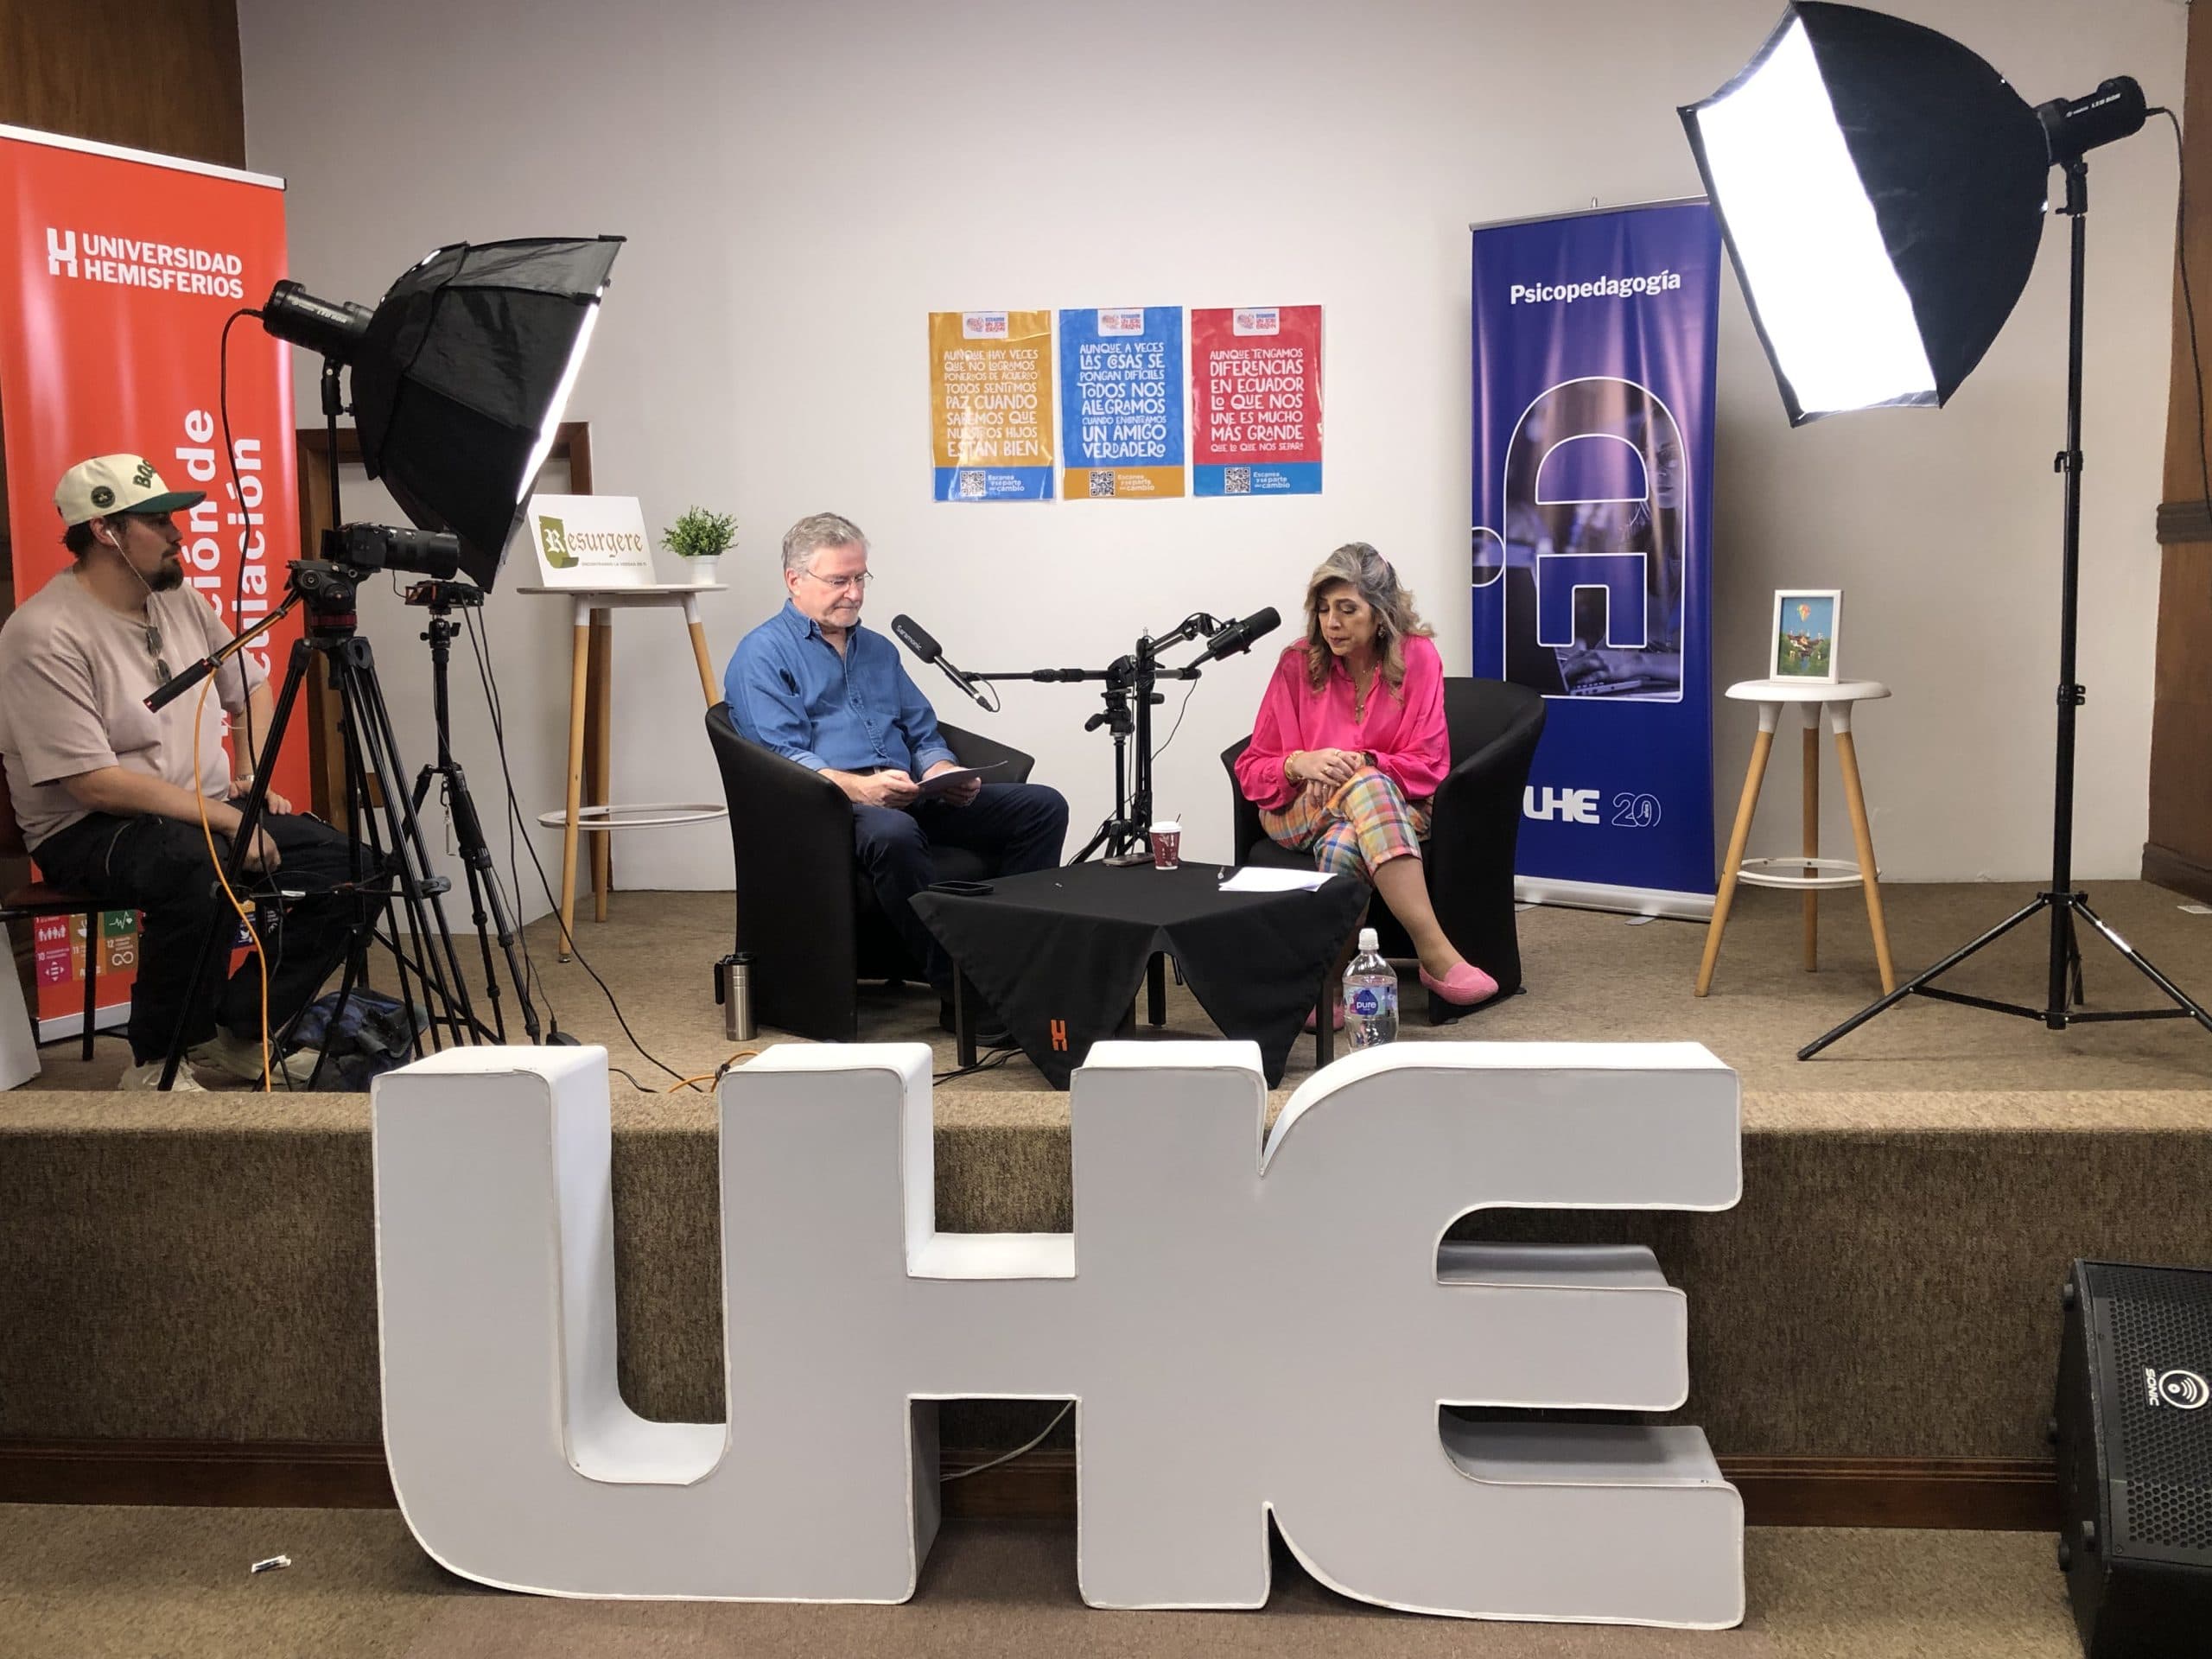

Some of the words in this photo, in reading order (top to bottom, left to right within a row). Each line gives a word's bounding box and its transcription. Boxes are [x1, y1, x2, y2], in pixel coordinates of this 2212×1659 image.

[82, 233, 243, 276] UNIVERSIDAD
[84, 258, 244, 299] HEMISFERIOS
[1510, 270, 1681, 304] Psicopedagogía
[944, 348, 985, 360] AUNQUE
[988, 350, 1006, 359] HAY
[1009, 349, 1039, 359] VECES
[1080, 343, 1122, 354] AUNQUE
[1125, 344, 1132, 353] A
[1134, 342, 1164, 353] VECES
[1210, 350, 1250, 359] AUNQUE
[1250, 348, 1303, 359] TENGAMOS
[944, 361, 966, 372] QUE
[969, 361, 985, 372] NO
[988, 361, 1035, 371] LOGRAMOS
[1080, 355, 1102, 370] LAS
[1147, 353, 1166, 368] SE
[1210, 359, 1303, 377] DIFERENCIAS
[1080, 371, 1121, 381] PONGAN
[944, 383, 981, 394] TODOS
[984, 382, 1037, 393] SENTIMOS
[1077, 382, 1126, 398] TODOS
[1131, 382, 1166, 397] NOS
[1211, 379, 1231, 394] EN
[1237, 377, 1305, 393] ECUADOR
[946, 396, 969, 410] PAZ
[974, 395, 1038, 410] CUANDO
[1082, 398, 1166, 415] ALEGRAMOS
[1211, 395, 1224, 410] LO
[1230, 394, 1264, 410] QUE
[1269, 394, 1303, 409] NOS
[1008, 410, 1038, 424] QUE
[1082, 416, 1114, 425] CUANDO
[1211, 412, 1236, 424] UNE
[1240, 412, 1254, 423] ES
[1258, 410, 1303, 423] MUCHO
[1007, 427, 1038, 438] HIJOS
[1083, 425, 1107, 442] UN
[1113, 424, 1166, 441] AMIGO
[1211, 423, 1242, 441] MÁS
[1247, 424, 1305, 441] GRANDE
[175, 410, 216, 481] de
[1004, 440, 1039, 456] BIEN
[1083, 441, 1166, 458] VERDADERO
[1210, 443, 1228, 452] QUE
[1239, 442, 1257, 451] QUE
[1259, 442, 1276, 451] NOS
[544, 529, 644, 557] Resurgere
[1522, 785, 1600, 824] UHE
[107, 939, 114, 948] 12
[37, 952, 46, 961] 10
[371, 1041, 1746, 1630] UHE
[2145, 1367, 2159, 1407] SONIC
